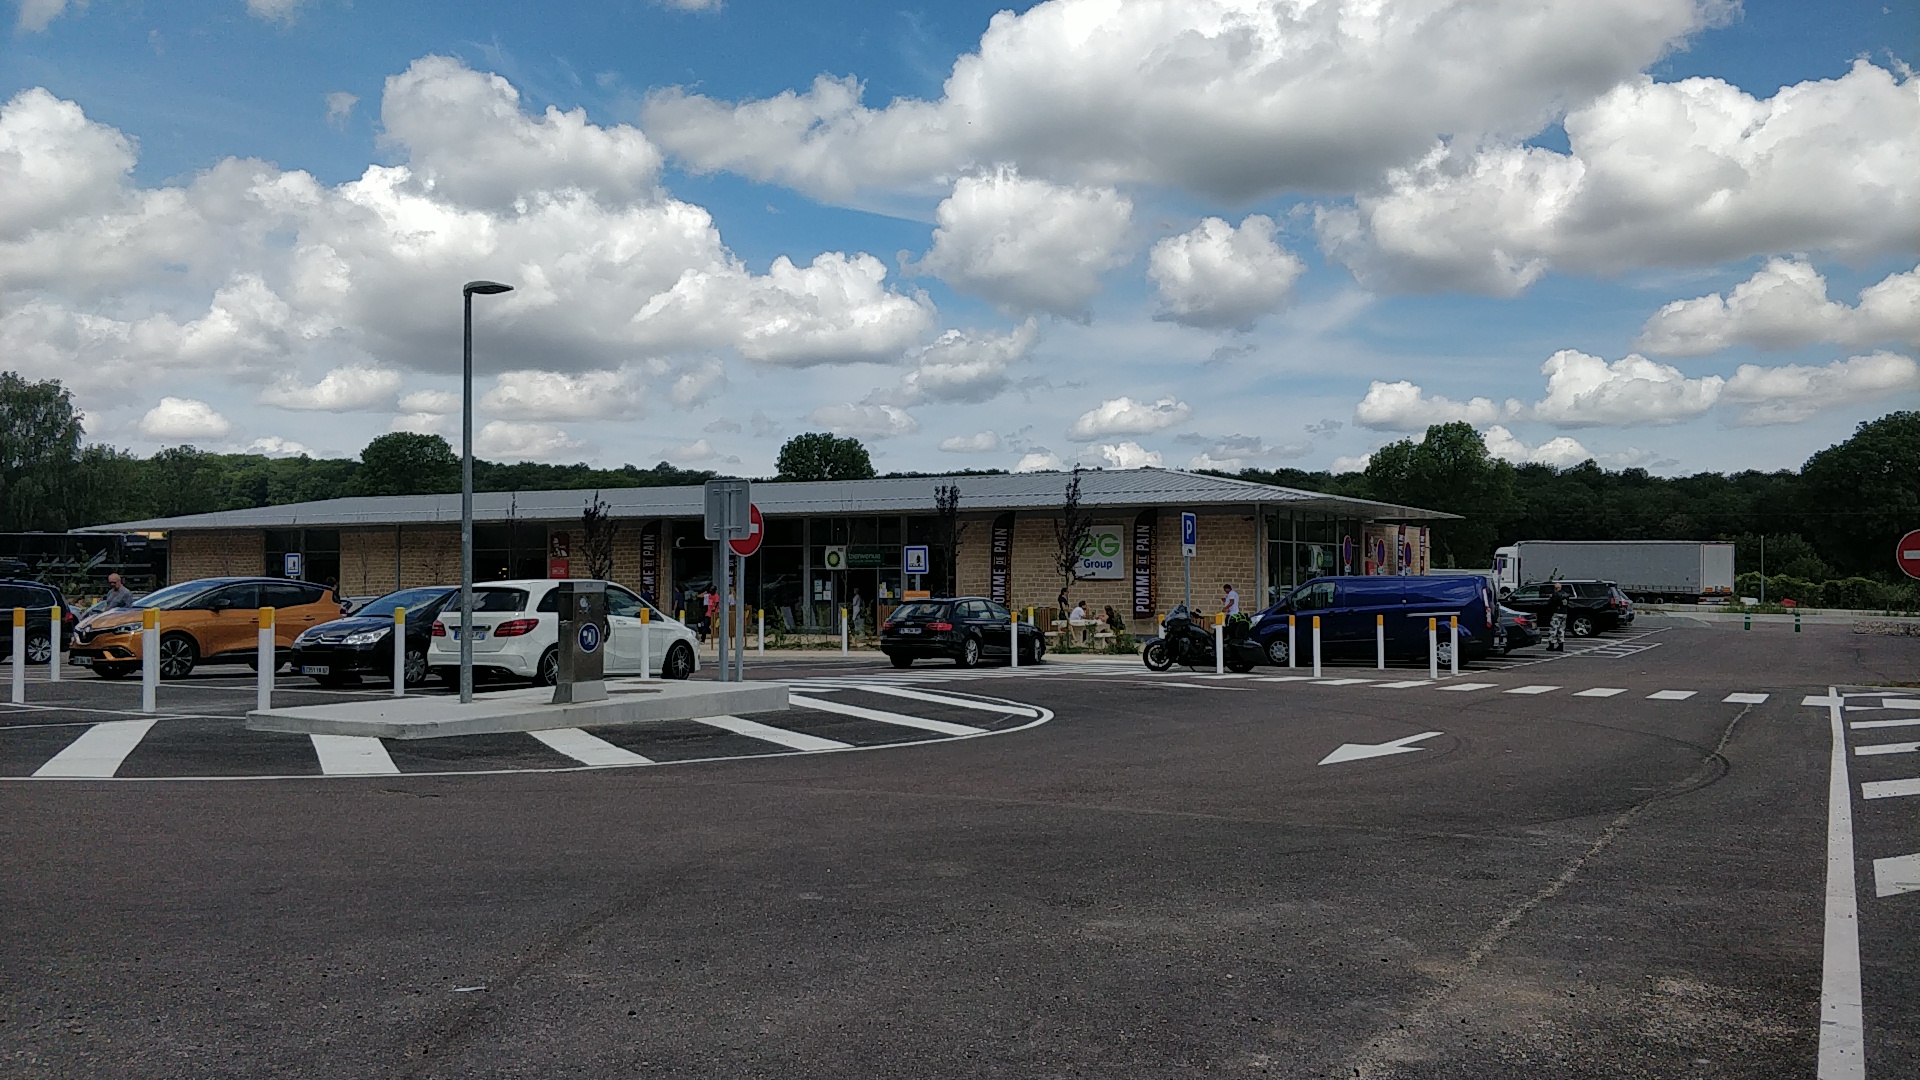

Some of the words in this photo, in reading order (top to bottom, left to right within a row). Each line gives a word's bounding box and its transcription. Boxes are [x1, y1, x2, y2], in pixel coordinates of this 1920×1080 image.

[994, 528, 1008, 553] PAIN
[1136, 525, 1150, 552] PAIN
[1186, 520, 1193, 540] P
[642, 534, 655, 557] PAIN
[995, 556, 1005, 565] DE
[1083, 559, 1113, 570] Group
[1138, 554, 1148, 565] DE
[993, 568, 1006, 604] OMME
[1136, 567, 1150, 613] POMME
